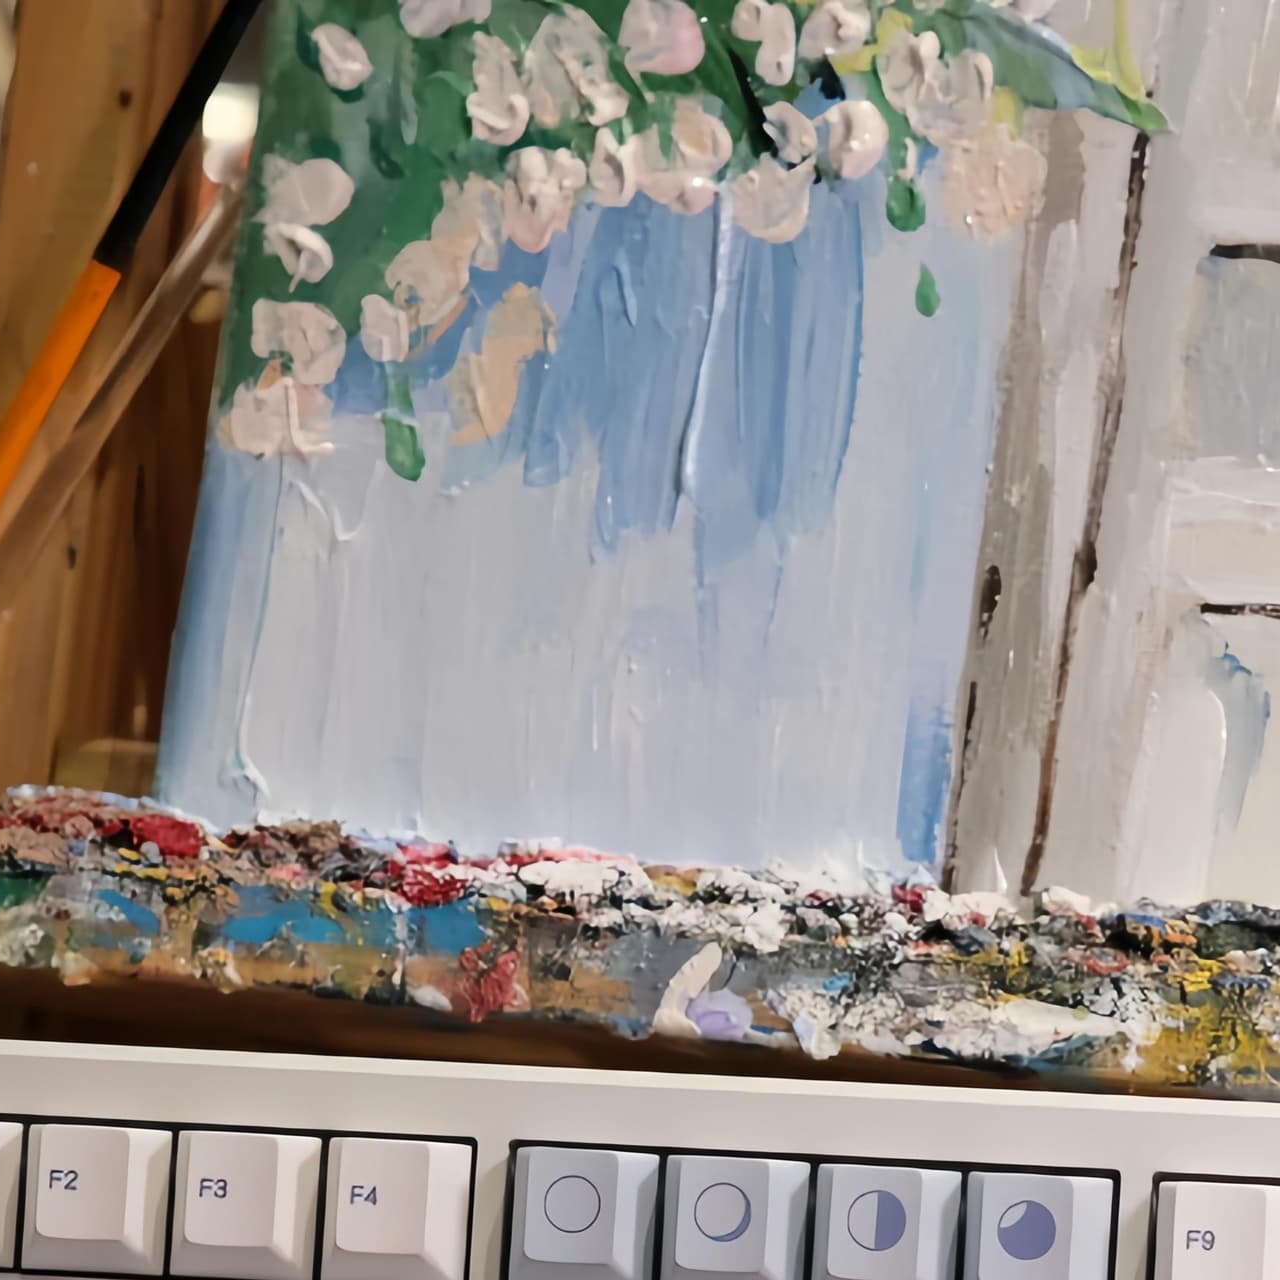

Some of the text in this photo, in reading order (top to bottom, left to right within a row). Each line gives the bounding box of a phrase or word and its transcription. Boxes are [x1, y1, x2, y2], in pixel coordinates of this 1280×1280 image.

[48, 1169, 79, 1191] F2
[198, 1178, 228, 1199] F3
[349, 1185, 378, 1206] F4
[1186, 1229, 1216, 1252] F9
